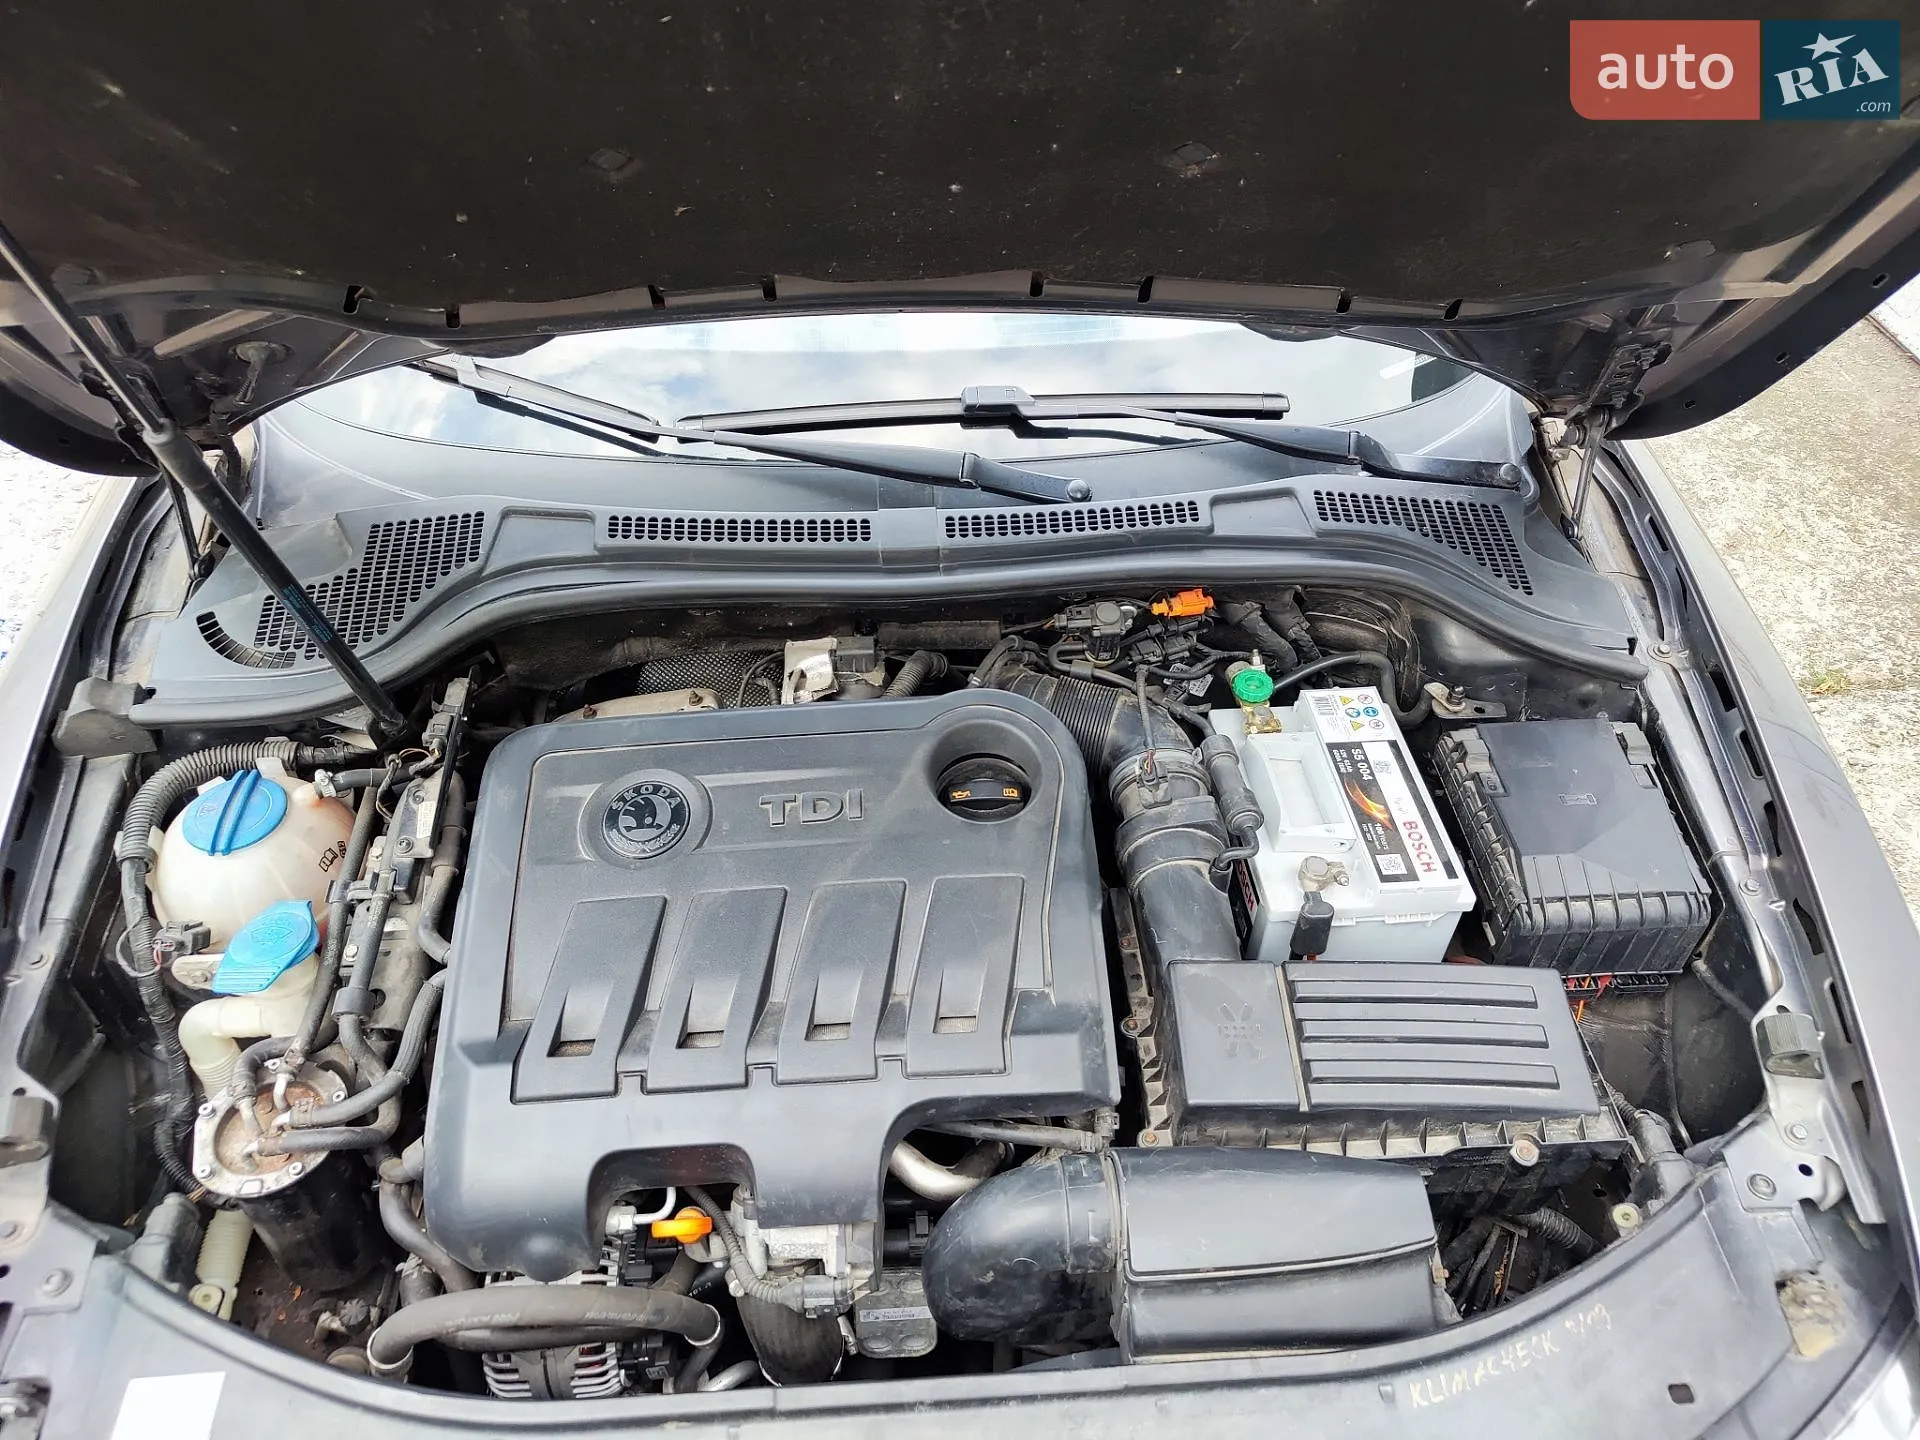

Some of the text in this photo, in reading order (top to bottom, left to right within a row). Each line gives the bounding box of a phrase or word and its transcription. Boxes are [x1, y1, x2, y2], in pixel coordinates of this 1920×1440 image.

[1357, 762, 1373, 781] 004
[759, 788, 864, 827] TDI
[1402, 820, 1437, 873] BOSCH
[1236, 861, 1257, 912] OSCH
